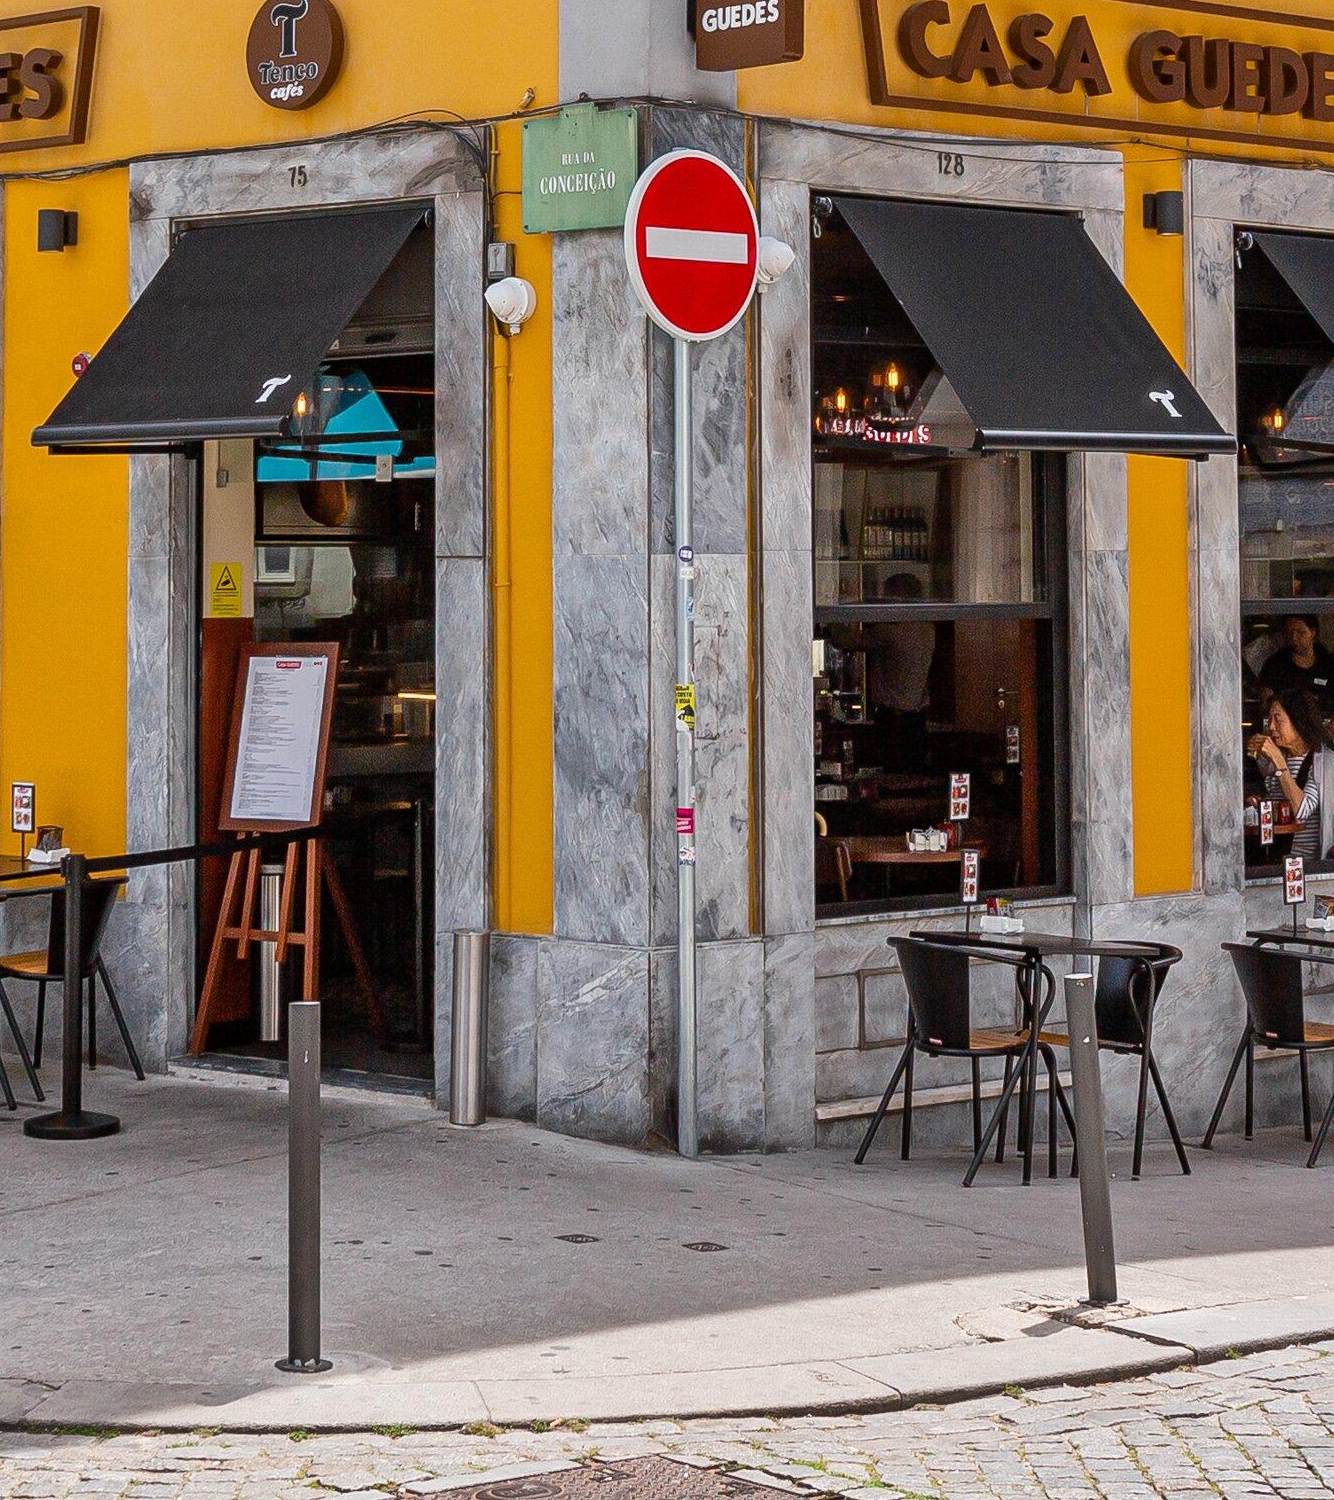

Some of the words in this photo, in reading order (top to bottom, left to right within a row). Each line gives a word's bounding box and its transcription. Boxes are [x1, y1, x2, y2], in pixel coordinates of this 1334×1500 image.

[898, 0, 1113, 97] CASA
[257, 60, 319, 85] Tenco
[270, 82, 305, 101] cafés
[561, 153, 581, 166] RUA
[582, 151, 596, 163] DA
[938, 151, 965, 177] 128
[287, 164, 309, 188] 75
[539, 168, 617, 195] CONCEIÇÃO
